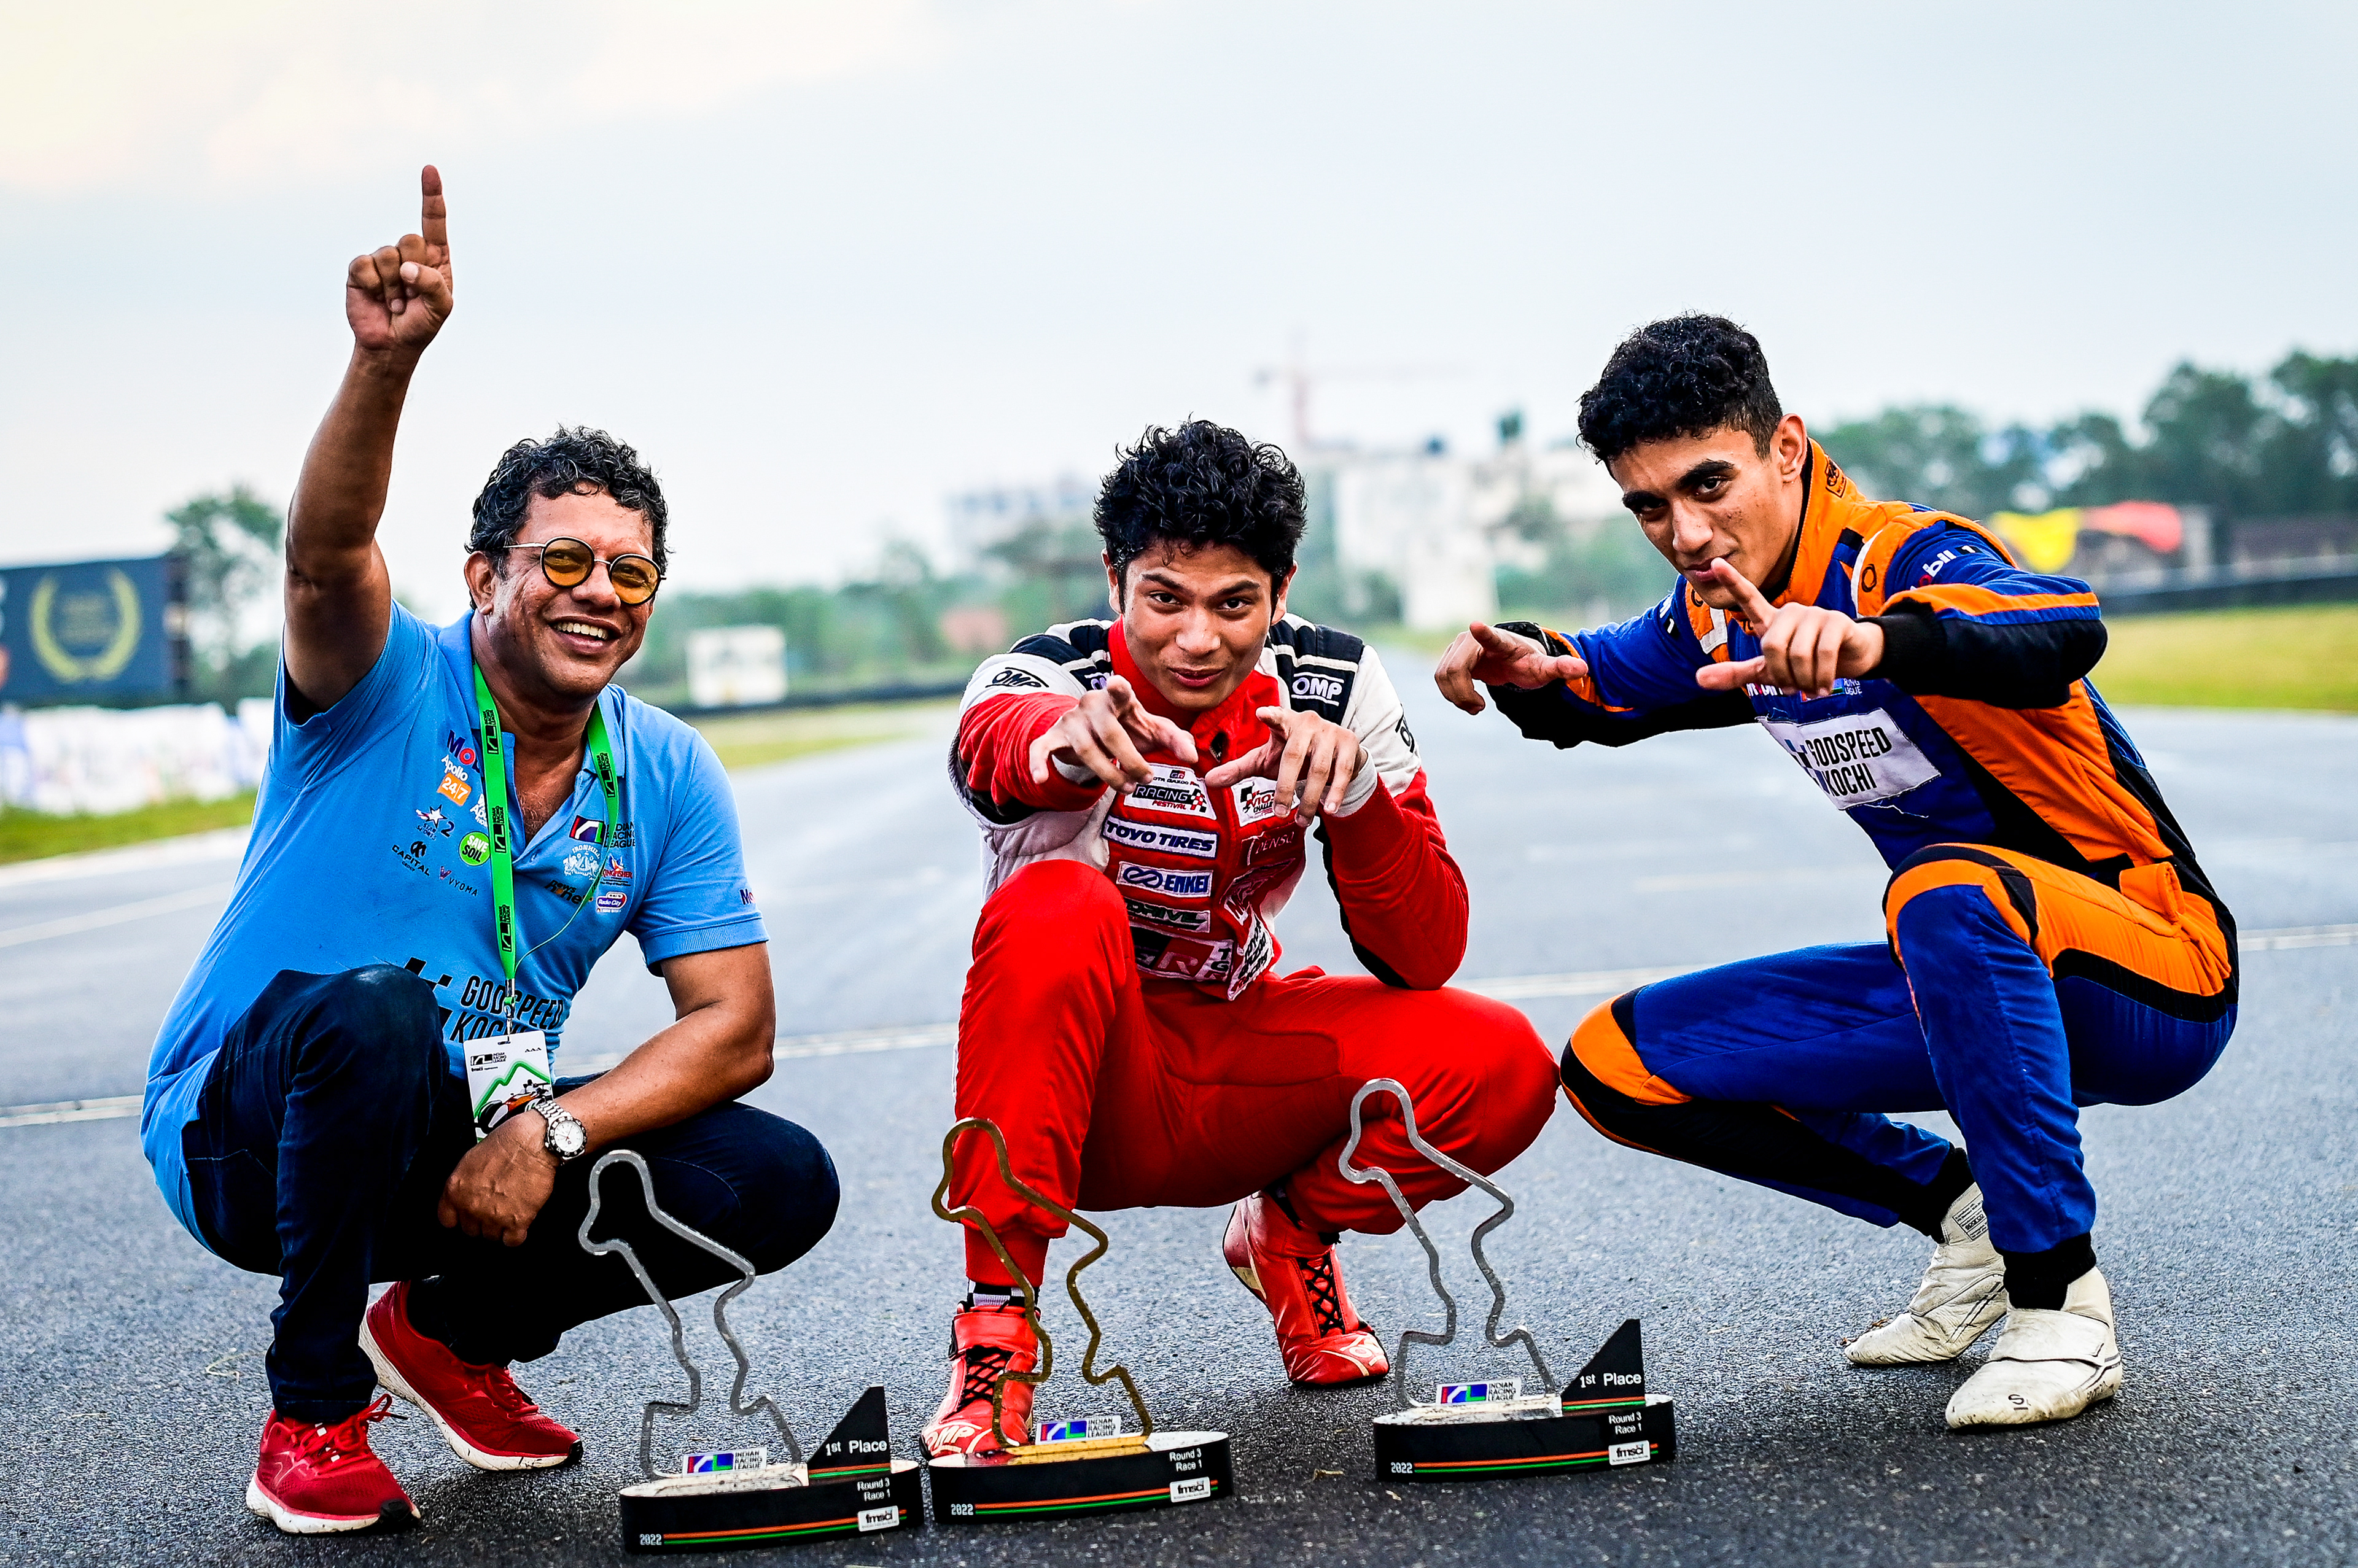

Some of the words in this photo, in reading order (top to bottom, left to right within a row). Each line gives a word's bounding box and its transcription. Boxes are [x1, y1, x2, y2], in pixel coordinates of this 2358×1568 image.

[1910, 549, 1956, 590] obil
[992, 670, 1042, 688] OMP
[1292, 677, 1342, 700] OMP
[1805, 727, 1892, 767] GODSPEED
[441, 754, 468, 782] Apollo
[1821, 763, 1877, 797] KOCHI
[1135, 786, 1189, 801] RACING
[1152, 800, 1186, 810] FESTIVAL
[440, 821, 455, 837] 2
[607, 821, 634, 831] IDIAN
[467, 835, 489, 853] SAVE
[1107, 820, 1156, 843] TOYO
[1159, 833, 1215, 852] TIRES
[462, 845, 483, 863] SOIL
[572, 844, 601, 860] IRONHILL
[392, 844, 430, 877] CAPITAL
[449, 877, 478, 896] VYOMA
[1164, 874, 1210, 893] ENKEI
[449, 1011, 528, 1043] KOC
[1580, 1374, 1596, 1388] 1st
[1603, 1372, 1642, 1386] Place
[1609, 1413, 1635, 1424] Round
[1636, 1411, 1641, 1421] 3
[1615, 1425, 1636, 1435] Race
[1638, 1422, 1641, 1431] 1
[825, 1441, 841, 1456] 1st
[849, 1440, 887, 1454] Place
[1169, 1449, 1195, 1462] Round
[1196, 1448, 1202, 1457] 3
[1176, 1462, 1196, 1472] Race
[1198, 1459, 1202, 1468] 1
[1391, 1462, 1412, 1473] 2022
[857, 1478, 883, 1491] Round
[885, 1477, 890, 1487] 3
[863, 1491, 885, 1501] Race
[887, 1489, 890, 1497] 1
[951, 1504, 974, 1515] 2022
[639, 1534, 662, 1545] 2022
